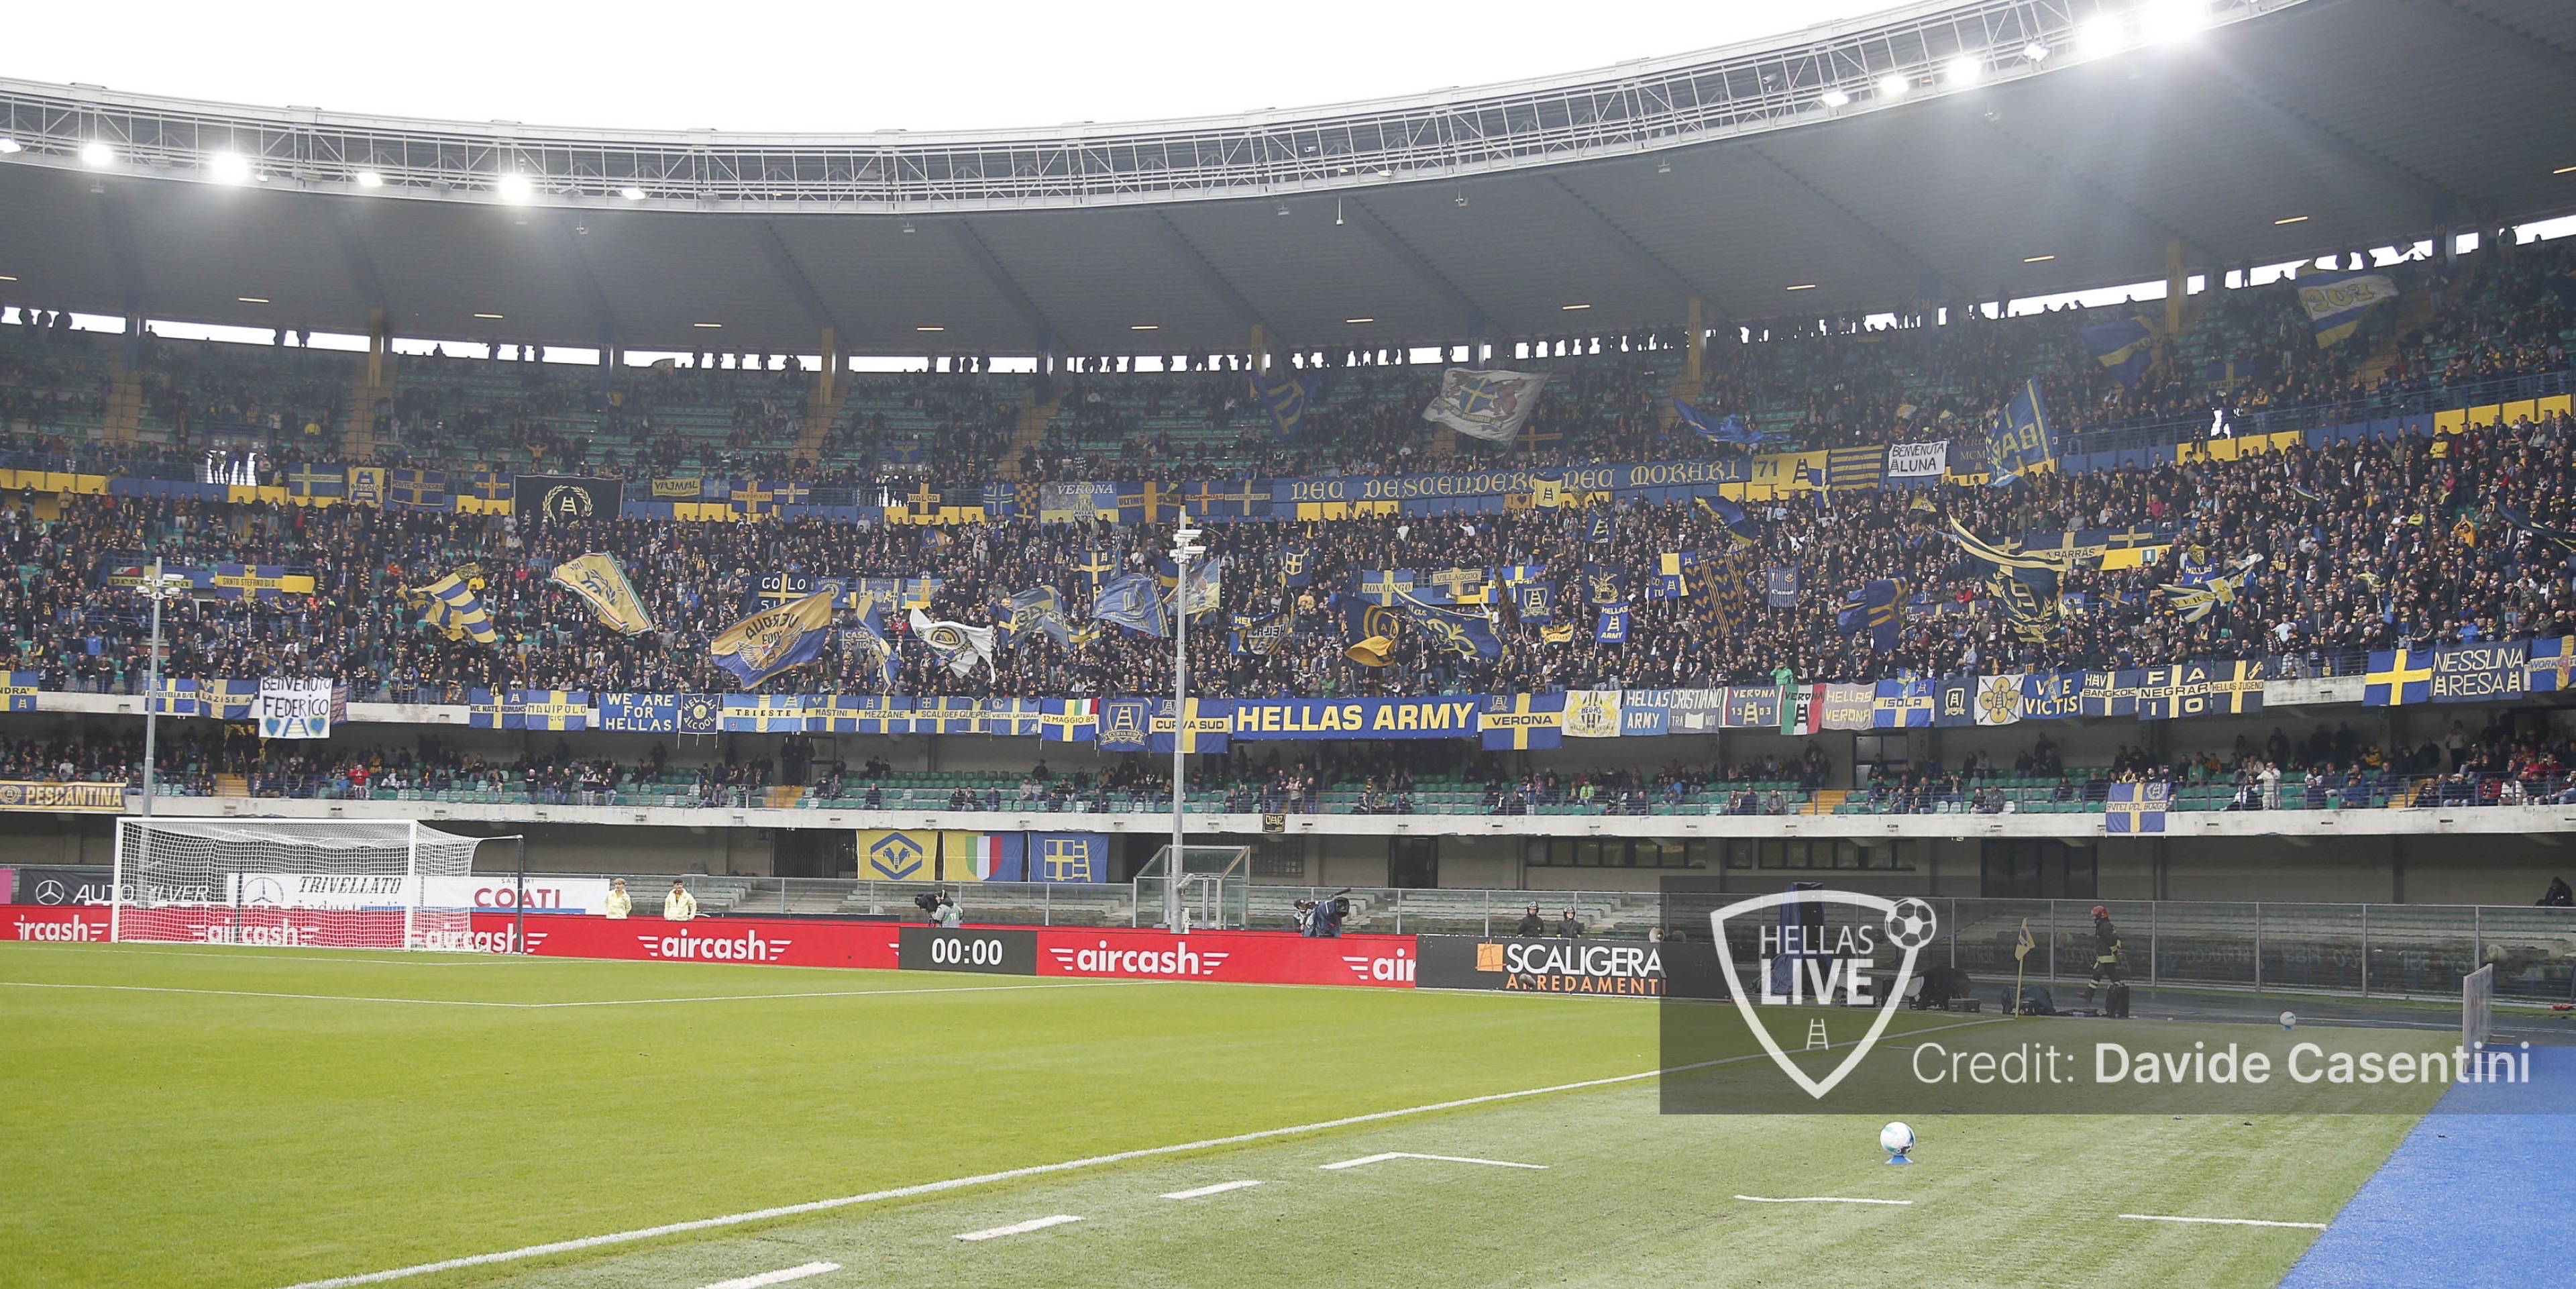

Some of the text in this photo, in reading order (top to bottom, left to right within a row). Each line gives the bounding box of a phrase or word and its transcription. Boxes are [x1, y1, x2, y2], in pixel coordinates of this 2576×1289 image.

[1891, 444, 1945, 458] BENVENUTA
[1057, 484, 1114, 495] VERONA
[1436, 572, 1479, 582] VILLAGGIO
[1601, 605, 1629, 614] HELLAS
[1601, 631, 1623, 639] ARMY
[2083, 688, 2135, 698] BANGKOK
[2141, 683, 2209, 699] NEGRAR
[2212, 681, 2263, 692] HELLAS JUGEND
[202, 693, 237, 703] LAZISE
[606, 693, 674, 707] WE ARE
[1625, 690, 1670, 708] HELLAS
[1670, 688, 1722, 709] CRISTIANO
[1733, 688, 1776, 699] VERONA
[1784, 691, 1824, 701] VERONA
[1827, 690, 1872, 703] HELLAS
[500, 705, 527, 713] HUMANS
[683, 694, 717, 712] HELLAS
[1883, 698, 1921, 708] ISOLA
[2025, 696, 2078, 716] VICTIS
[623, 706, 654, 718] FOR
[735, 709, 792, 717] TRIESTE
[815, 709, 848, 717] MASTINI
[865, 710, 905, 719] MEZZANE
[1236, 701, 1475, 732] HELLAS ARMY
[1581, 707, 1602, 715] HELLAS
[1825, 707, 1872, 722] VERONA
[605, 717, 672, 732] HELLAS
[1199, 721, 1224, 730] SUD
[1491, 715, 1554, 726] VERONA
[1627, 713, 1660, 729] ARMY
[25, 784, 123, 806] PESCANTINA
[474, 888, 561, 909] COATI
[425, 923, 522, 953] aircash
[661, 928, 766, 961] aircash
[930, 937, 1003, 966] 00:00
[1077, 940, 1199, 975] aircash
[1505, 943, 1667, 978] SCALIGERA
